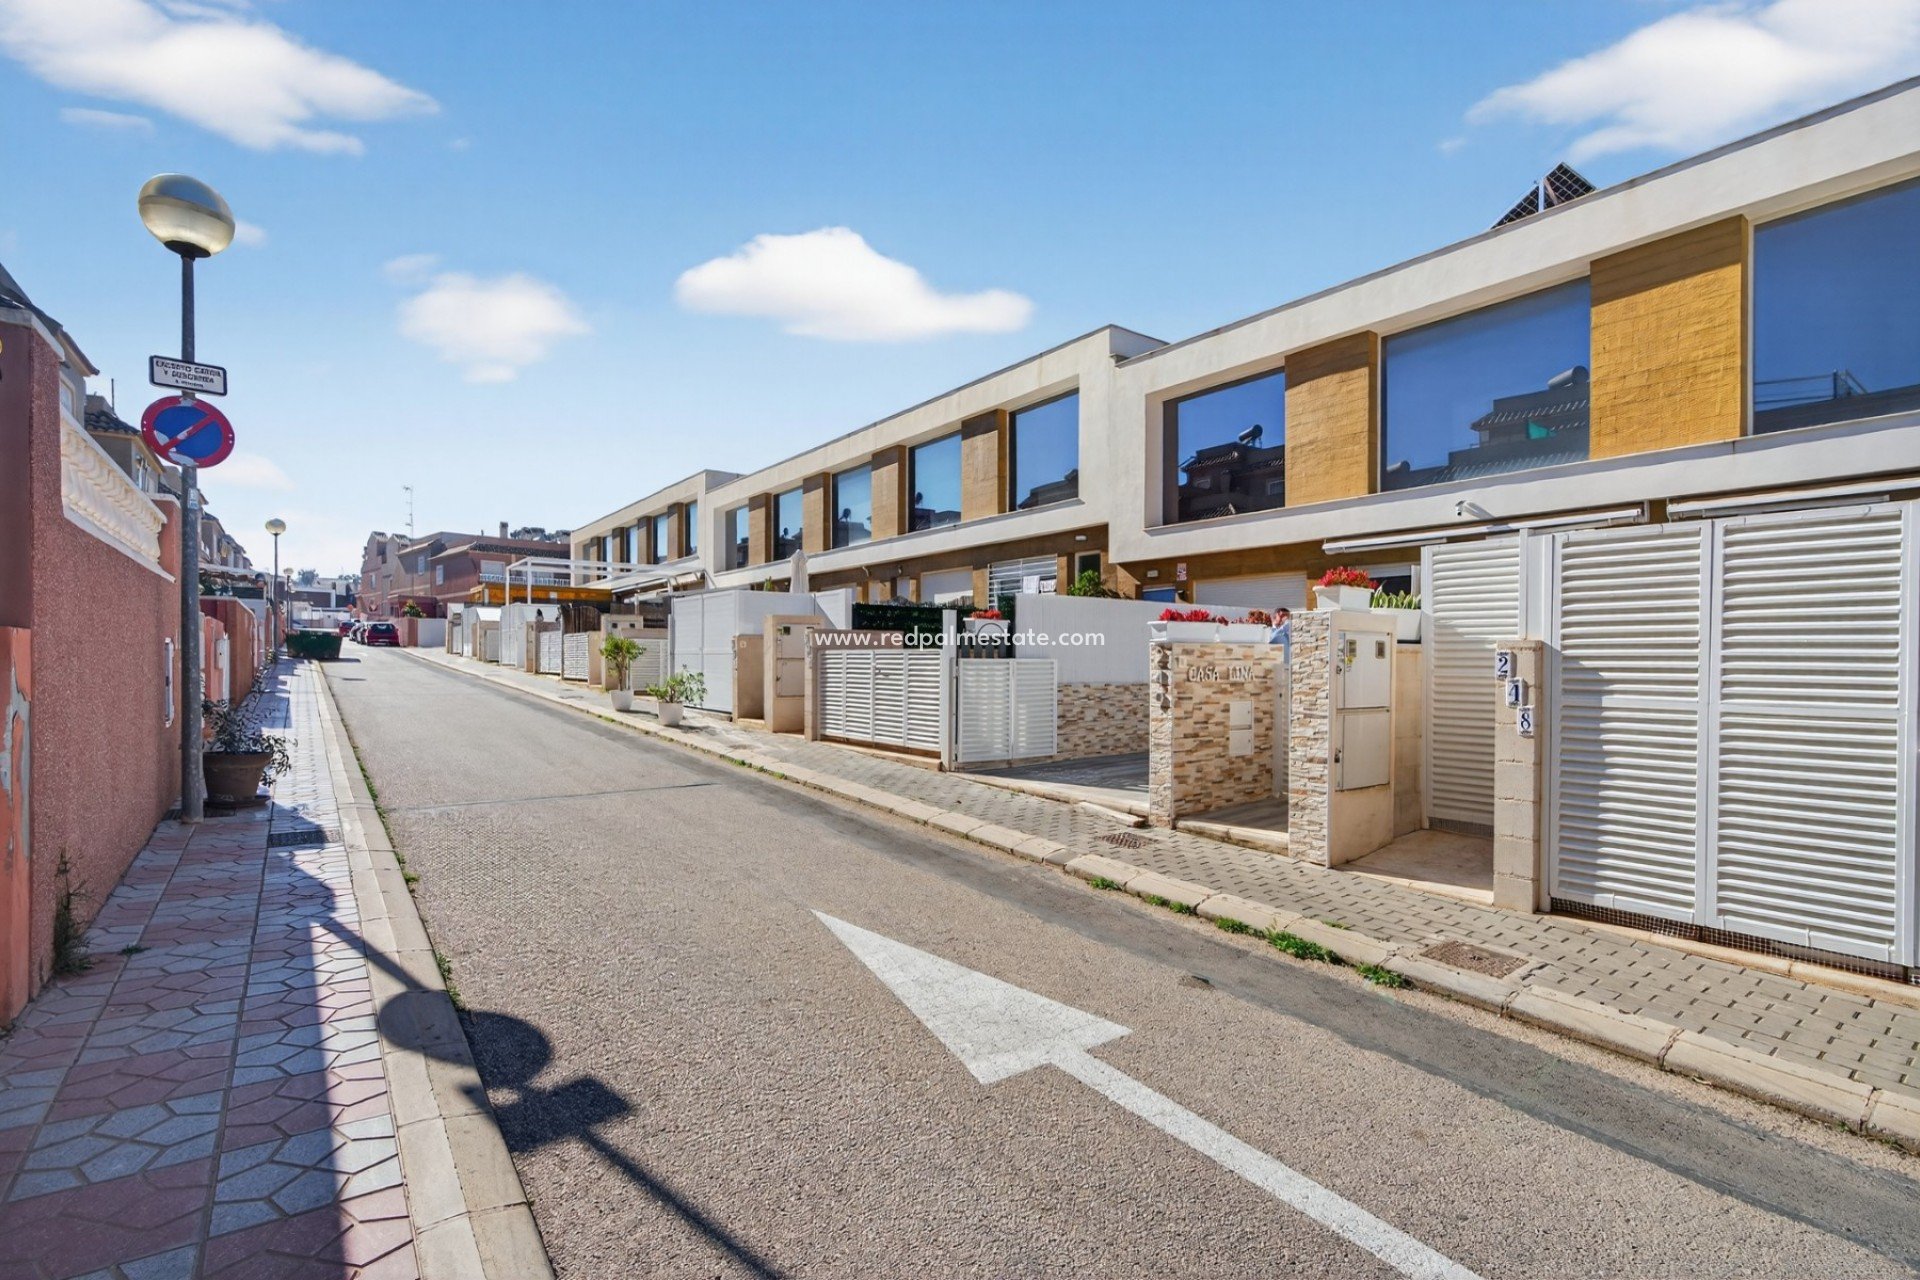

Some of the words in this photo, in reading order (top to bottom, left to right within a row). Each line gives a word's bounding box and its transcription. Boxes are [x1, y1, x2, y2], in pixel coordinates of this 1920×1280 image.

[1188, 665, 1220, 682] CASA
[1497, 656, 1509, 674] 2
[1520, 712, 1531, 731] 8
